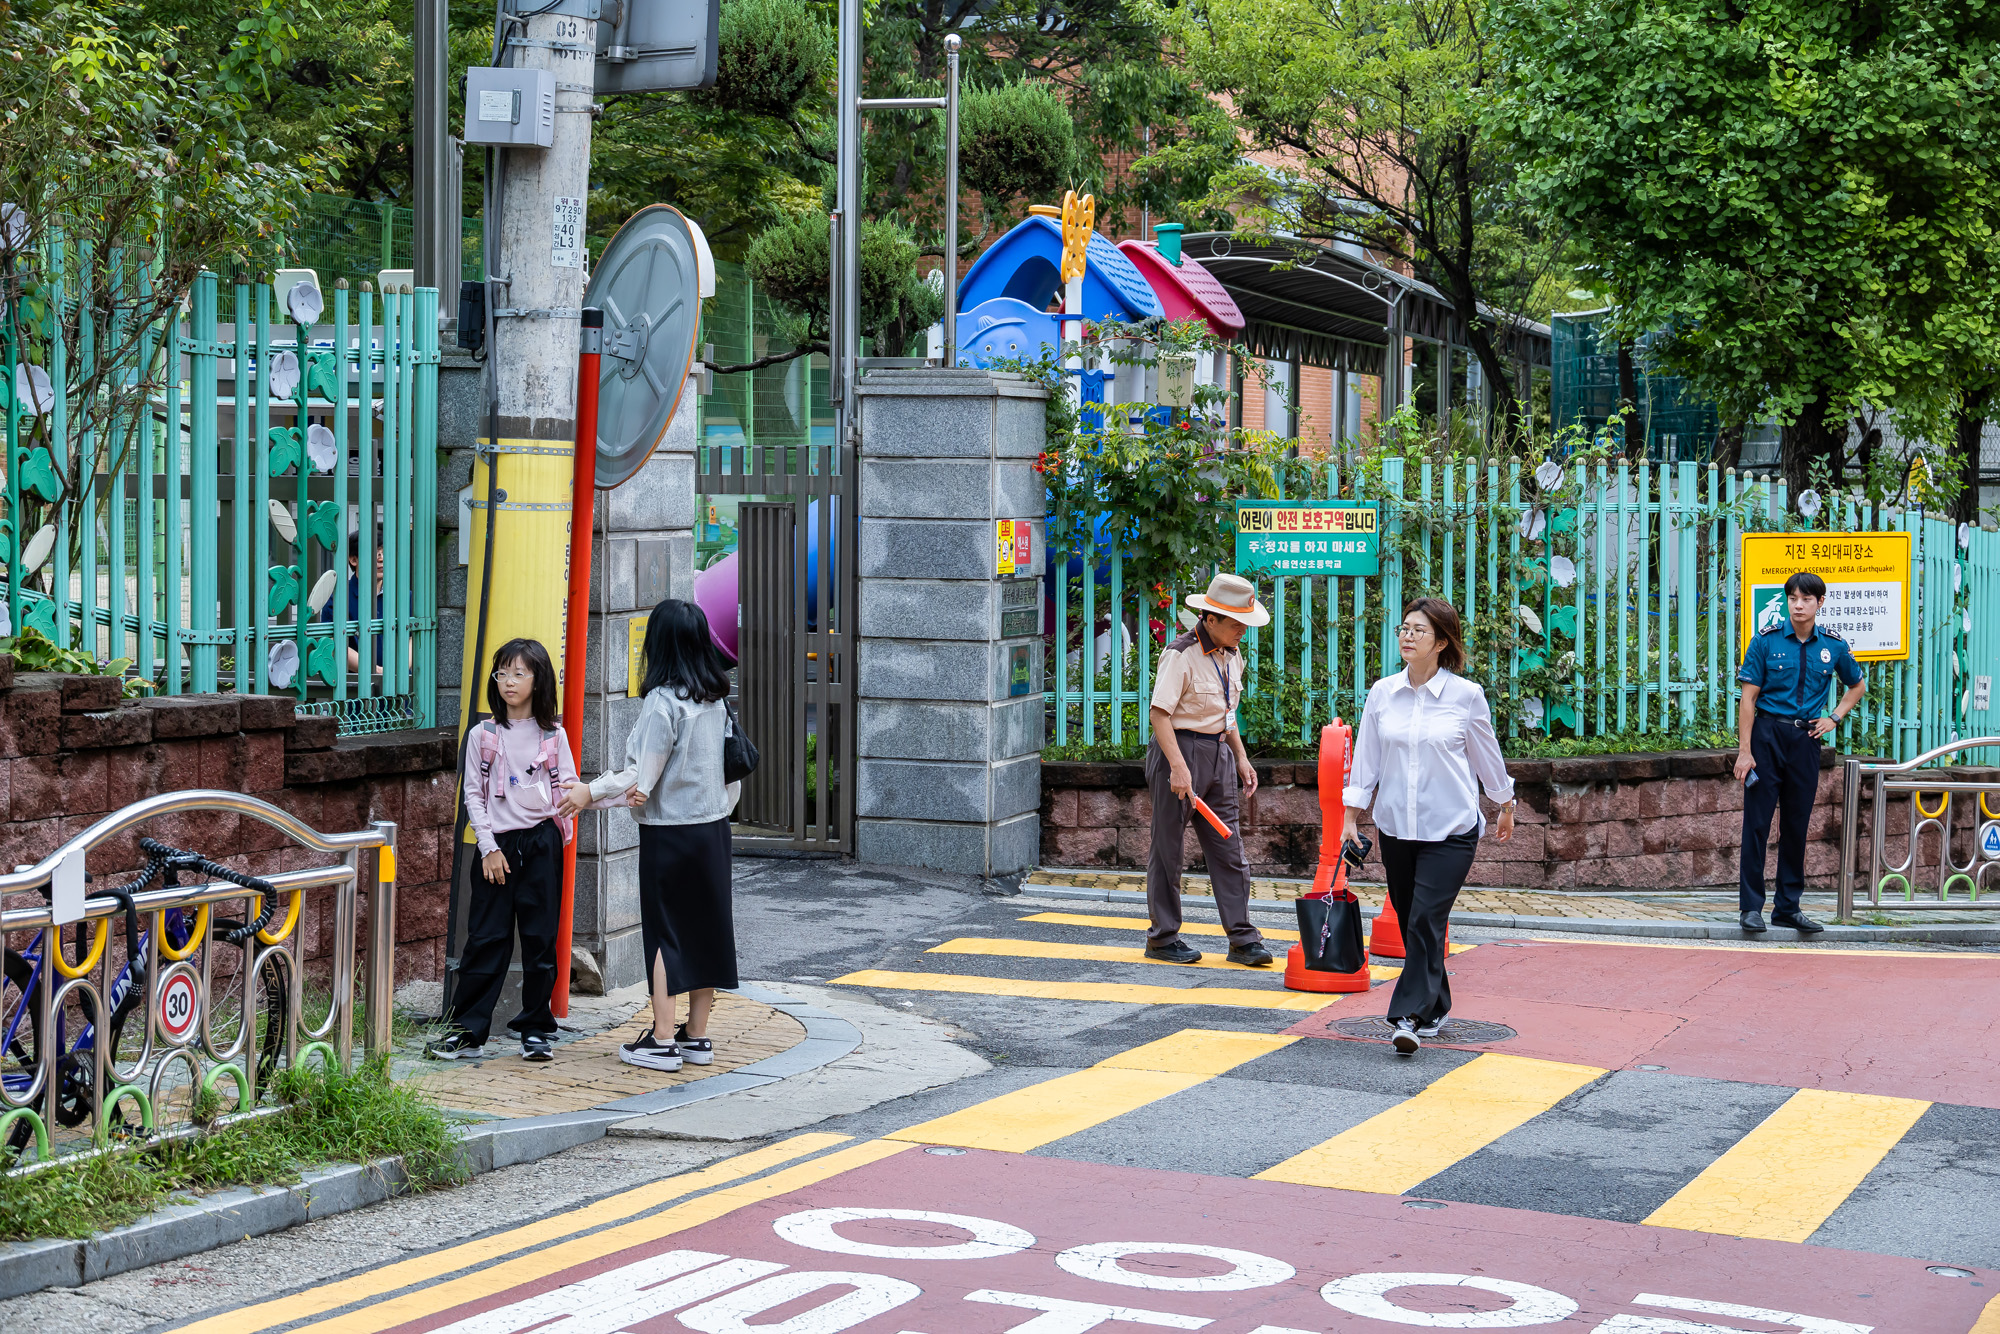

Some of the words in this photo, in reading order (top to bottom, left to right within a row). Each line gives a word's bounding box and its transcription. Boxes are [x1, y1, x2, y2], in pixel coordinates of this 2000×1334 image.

[562, 214, 577, 223] 132
[1241, 510, 1272, 531] 어린이
[1277, 511, 1298, 531] 안전
[1302, 511, 1374, 531] 보호구역입니다
[1304, 541, 1327, 553] 하지
[1332, 541, 1367, 553] 마세요
[1785, 544, 1806, 560] 지진
[1810, 543, 1874, 560] 옥외대피장소
[1274, 559, 1342, 569] 서울연신초등학교
[1761, 566, 1802, 575] EMERGENCY
[1803, 566, 1837, 574] ASSEMBLY
[1856, 564, 1895, 574] (Earthquake)
[1829, 591, 1842, 600] 지진
[1843, 590, 1863, 600] 발생에
[1864, 589, 1889, 599] 대비하여
[1829, 606, 1842, 616] 긴급
[1856, 622, 1874, 632] 운동장
[168, 991, 188, 1018] 30
